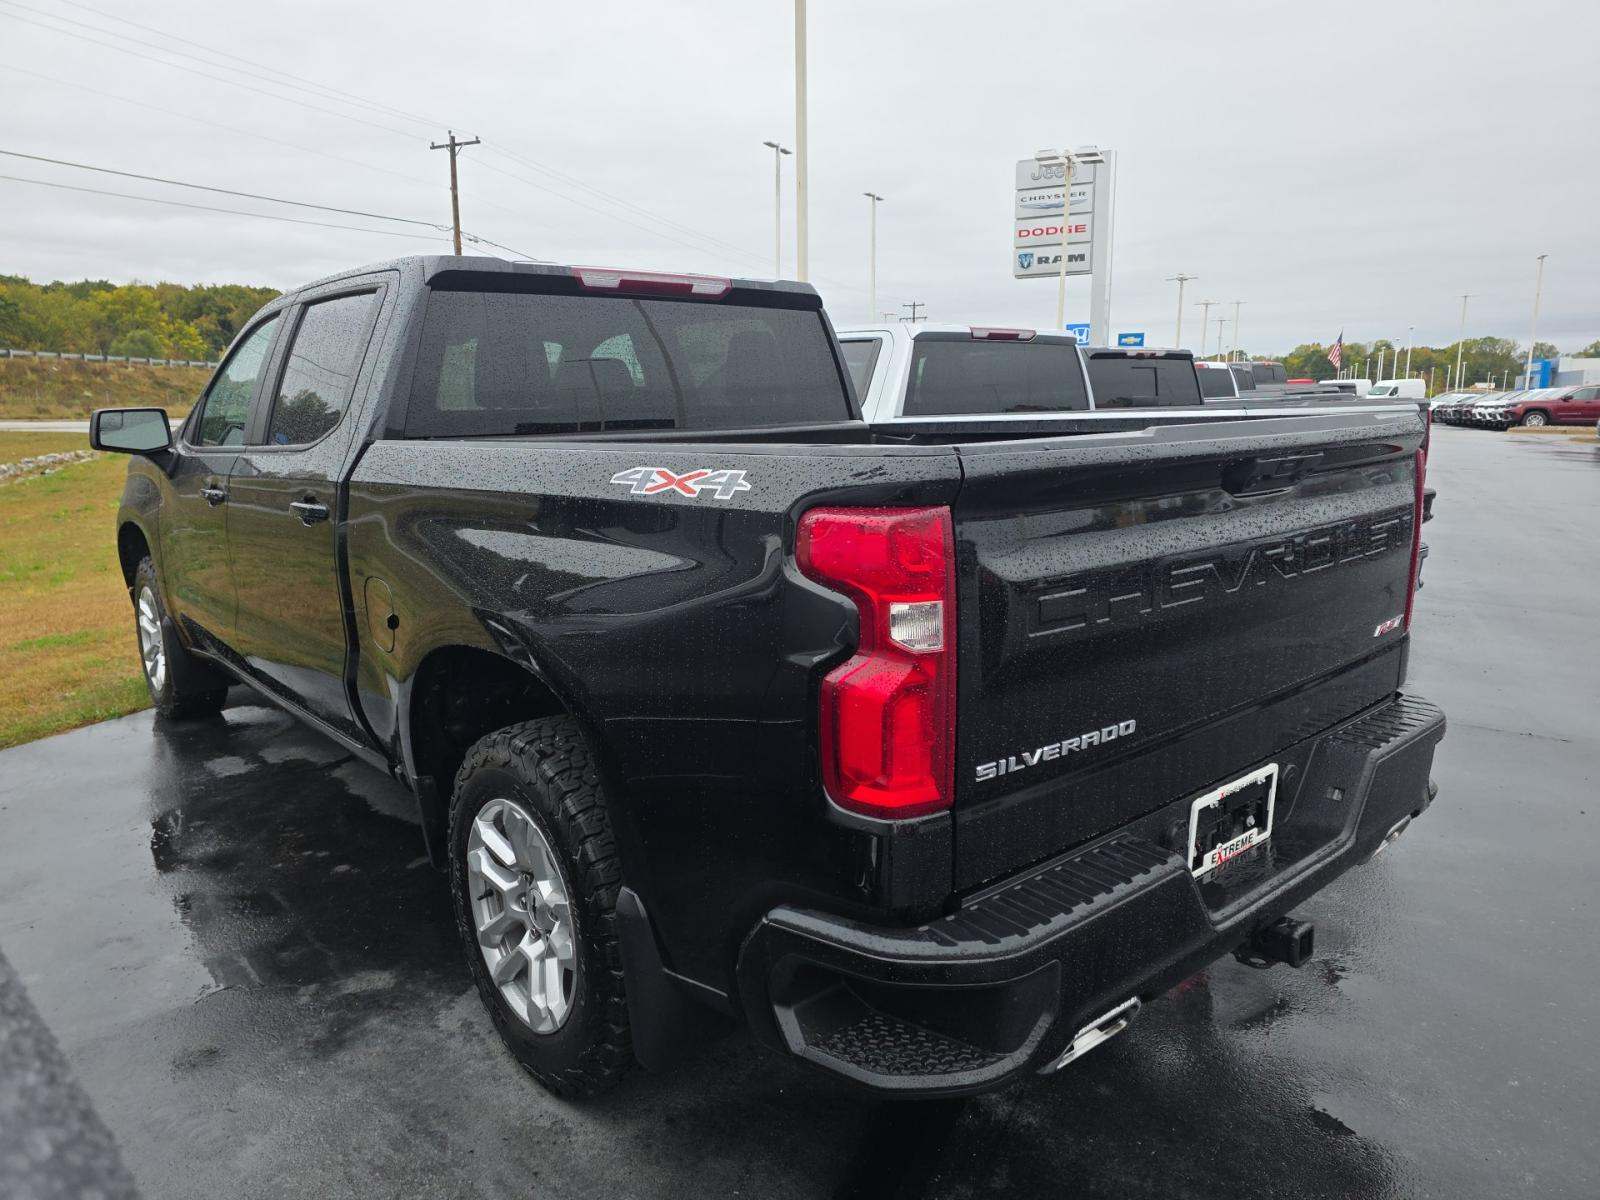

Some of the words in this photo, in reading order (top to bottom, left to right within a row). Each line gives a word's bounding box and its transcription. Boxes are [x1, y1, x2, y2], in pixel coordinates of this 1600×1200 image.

[1018, 224, 1087, 238] DODGE
[1037, 253, 1086, 265] RAM
[1028, 513, 1412, 638] CHEVROLET
[975, 719, 1137, 783] SILVERADO
[1211, 832, 1254, 864] EXTREME
